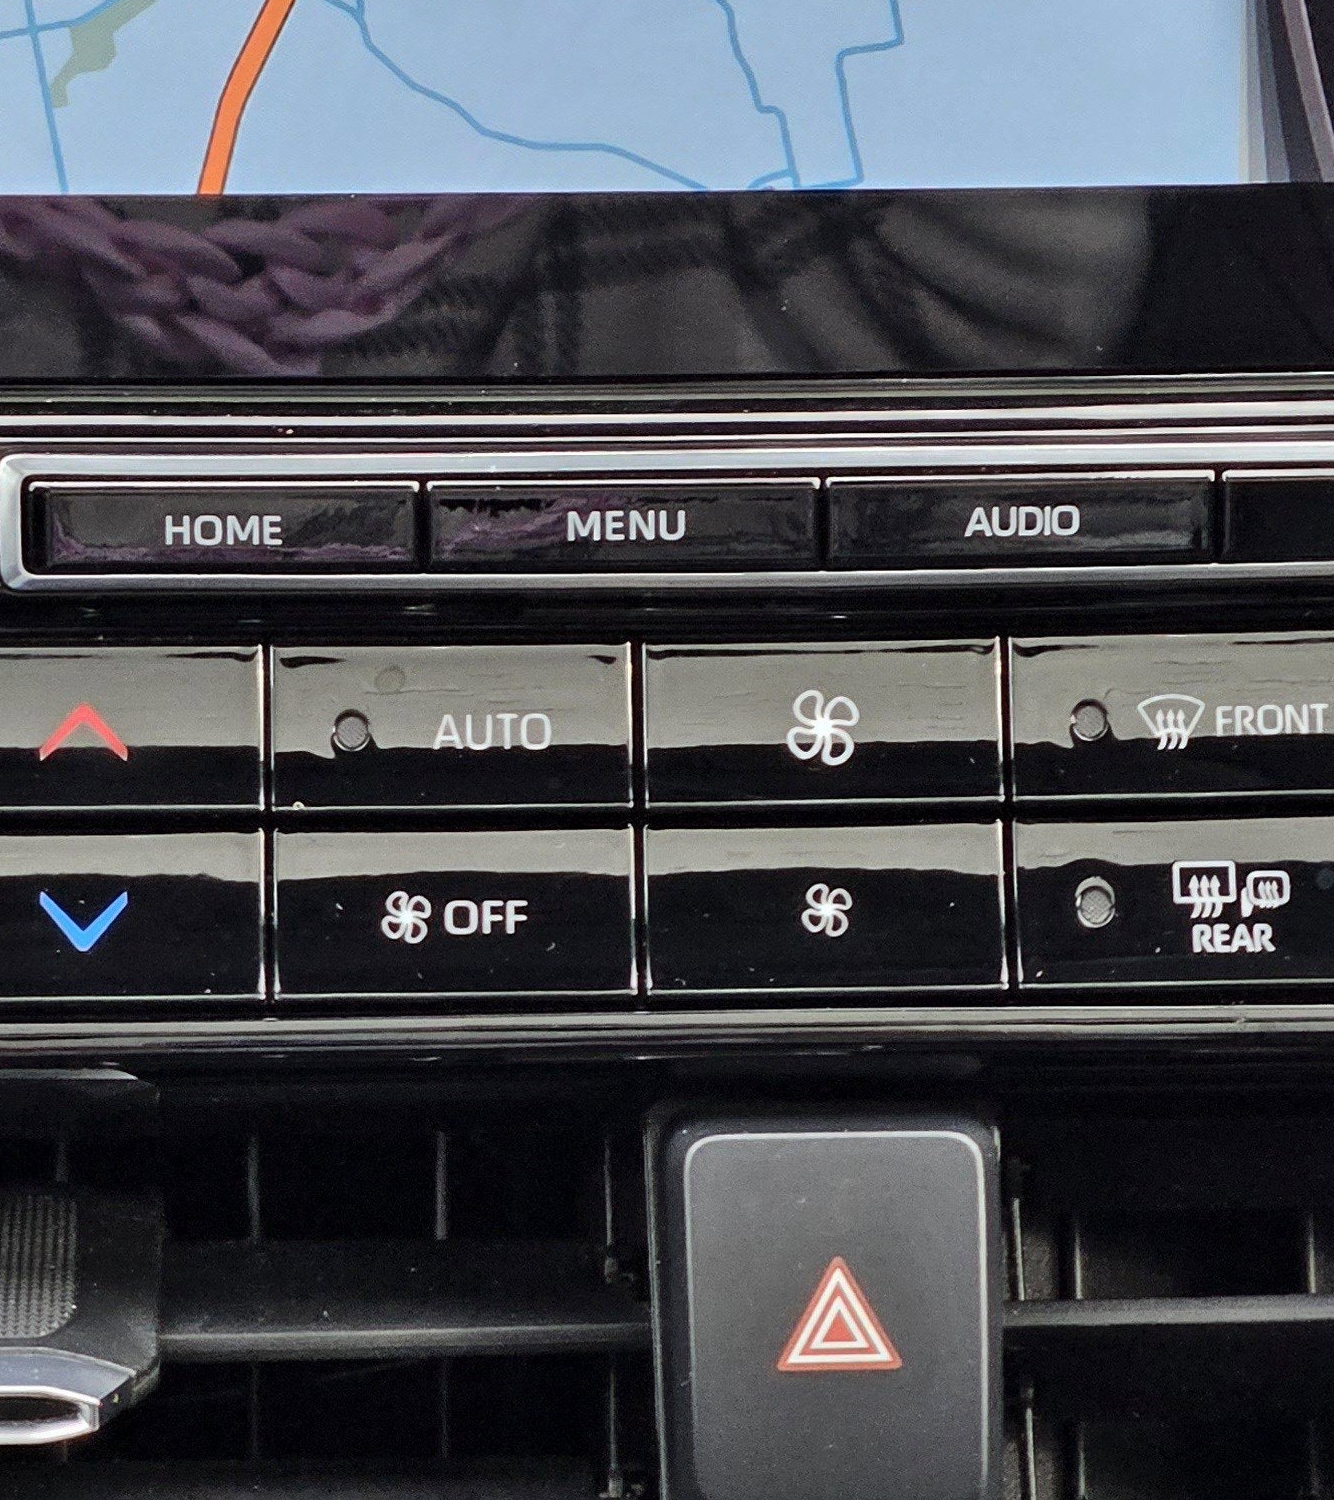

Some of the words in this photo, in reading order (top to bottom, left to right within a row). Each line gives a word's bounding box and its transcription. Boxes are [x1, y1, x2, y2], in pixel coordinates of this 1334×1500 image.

[164, 514, 284, 546] HOME
[567, 509, 687, 543] MENU
[964, 505, 1081, 537] AUDIO
[432, 711, 552, 751] AUTO
[1213, 700, 1331, 738] FRONT
[442, 898, 529, 935] OFF
[1189, 919, 1275, 955] REAR
